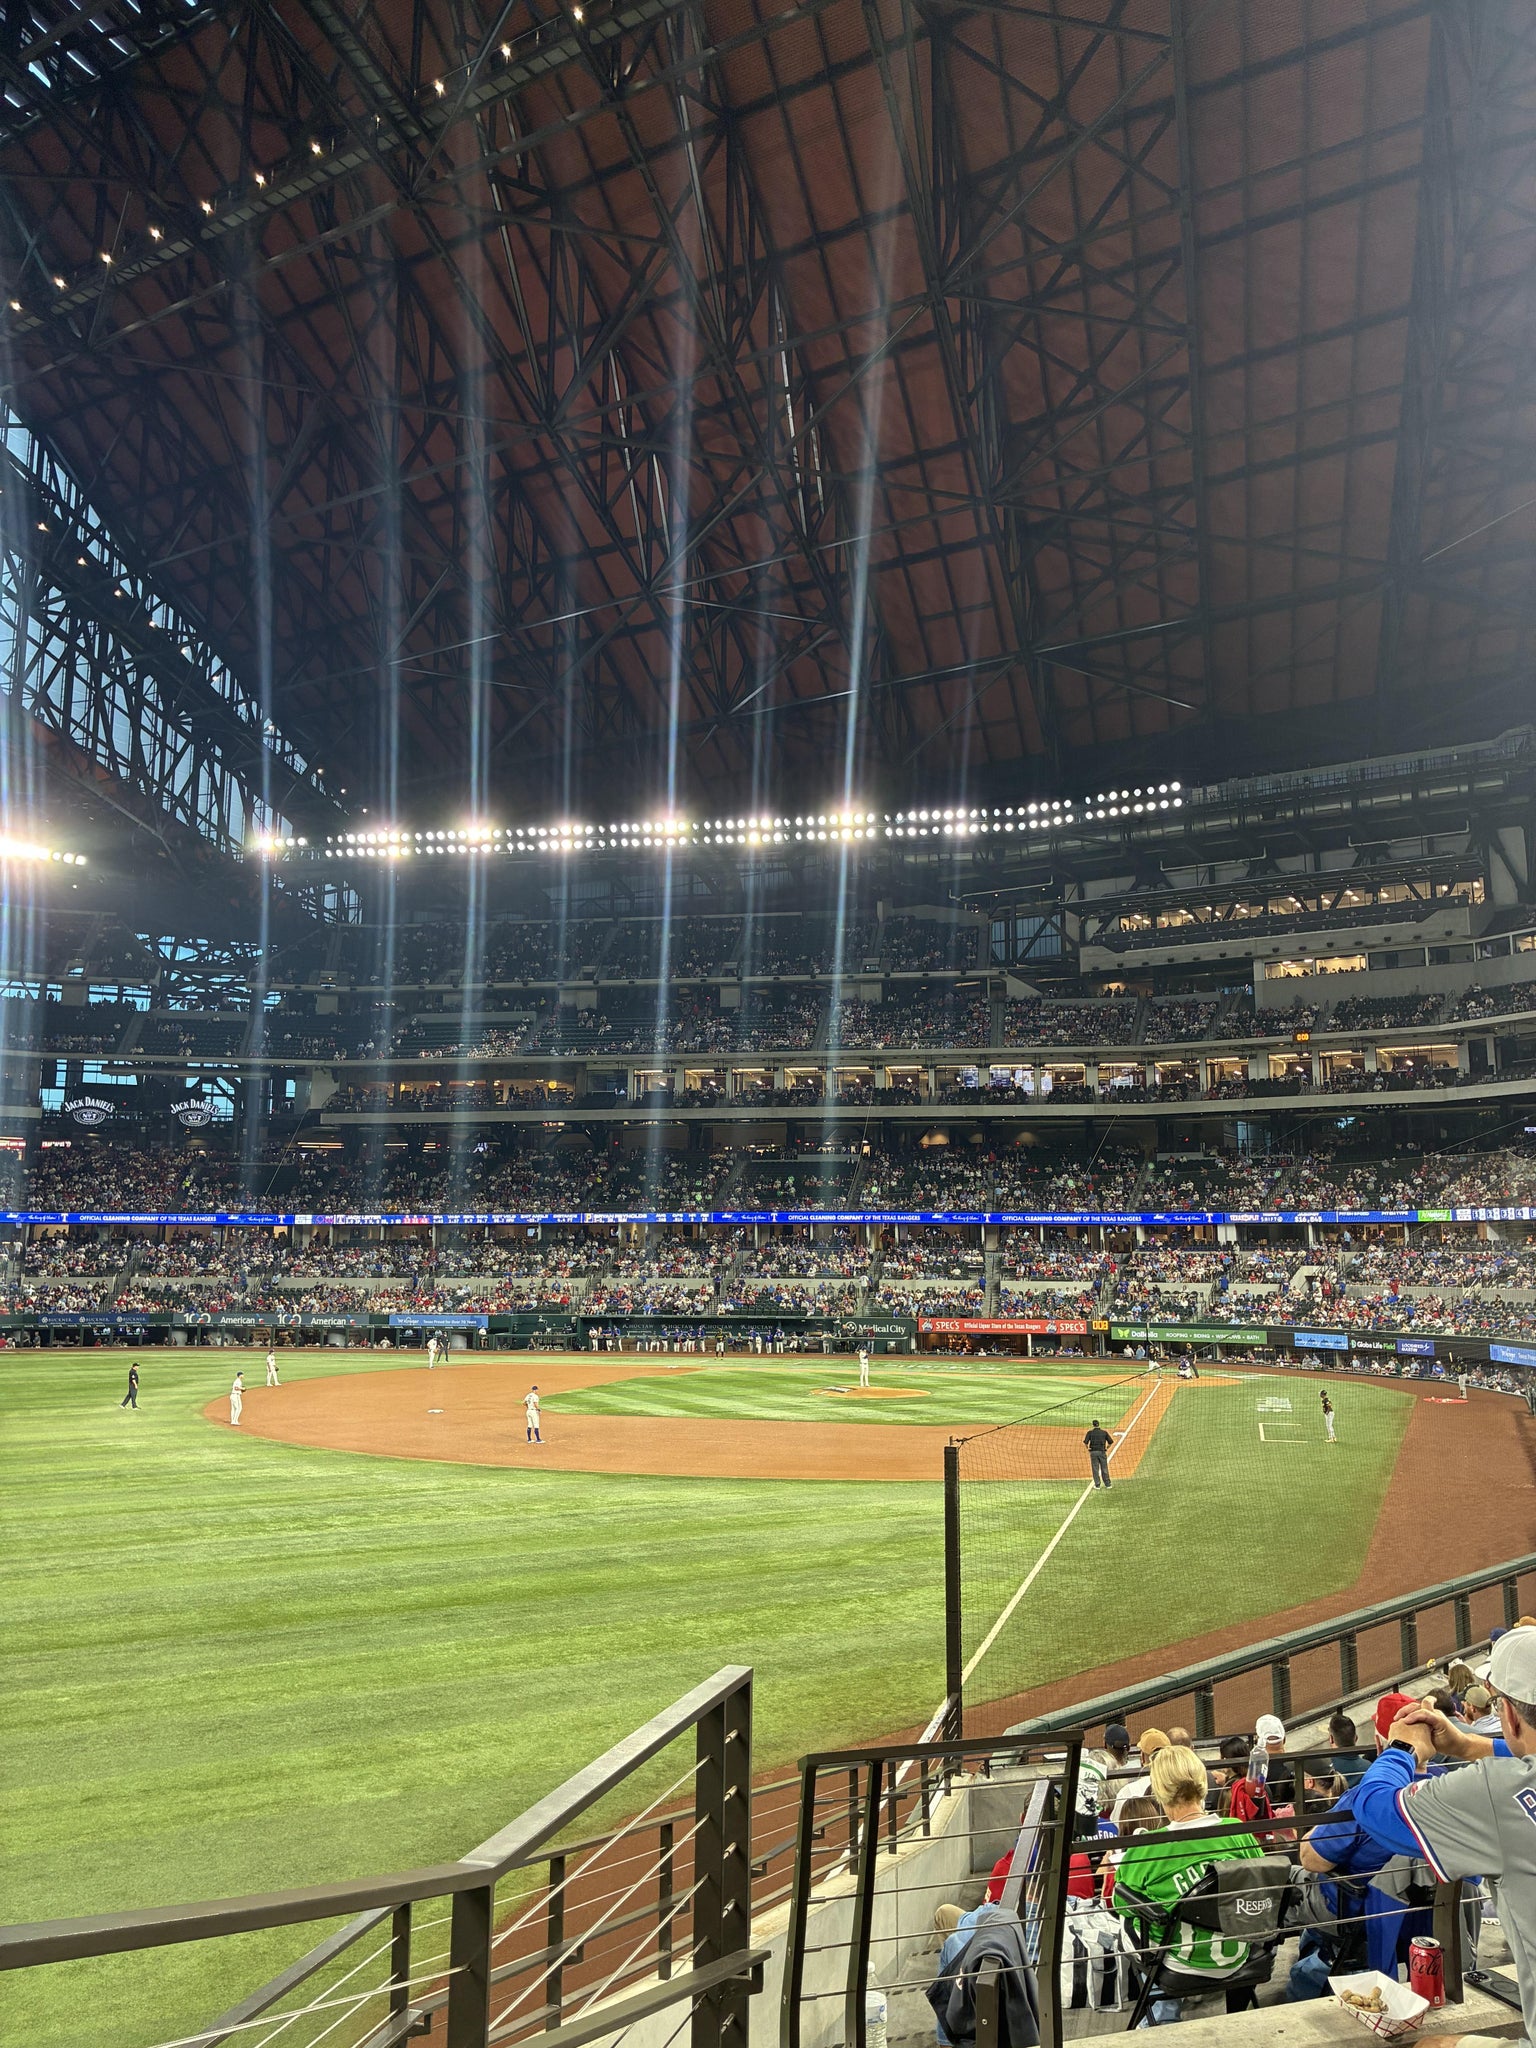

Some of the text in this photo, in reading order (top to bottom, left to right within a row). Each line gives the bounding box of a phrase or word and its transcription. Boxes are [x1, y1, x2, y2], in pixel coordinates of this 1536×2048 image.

[65, 1096, 116, 1113] JACK DANIEL'S
[170, 1099, 220, 1115] JACK DANIEL'S
[890, 1324, 906, 1334] City
[936, 1320, 960, 1329] SPEC'S
[1060, 1322, 1084, 1331] SPEC'S
